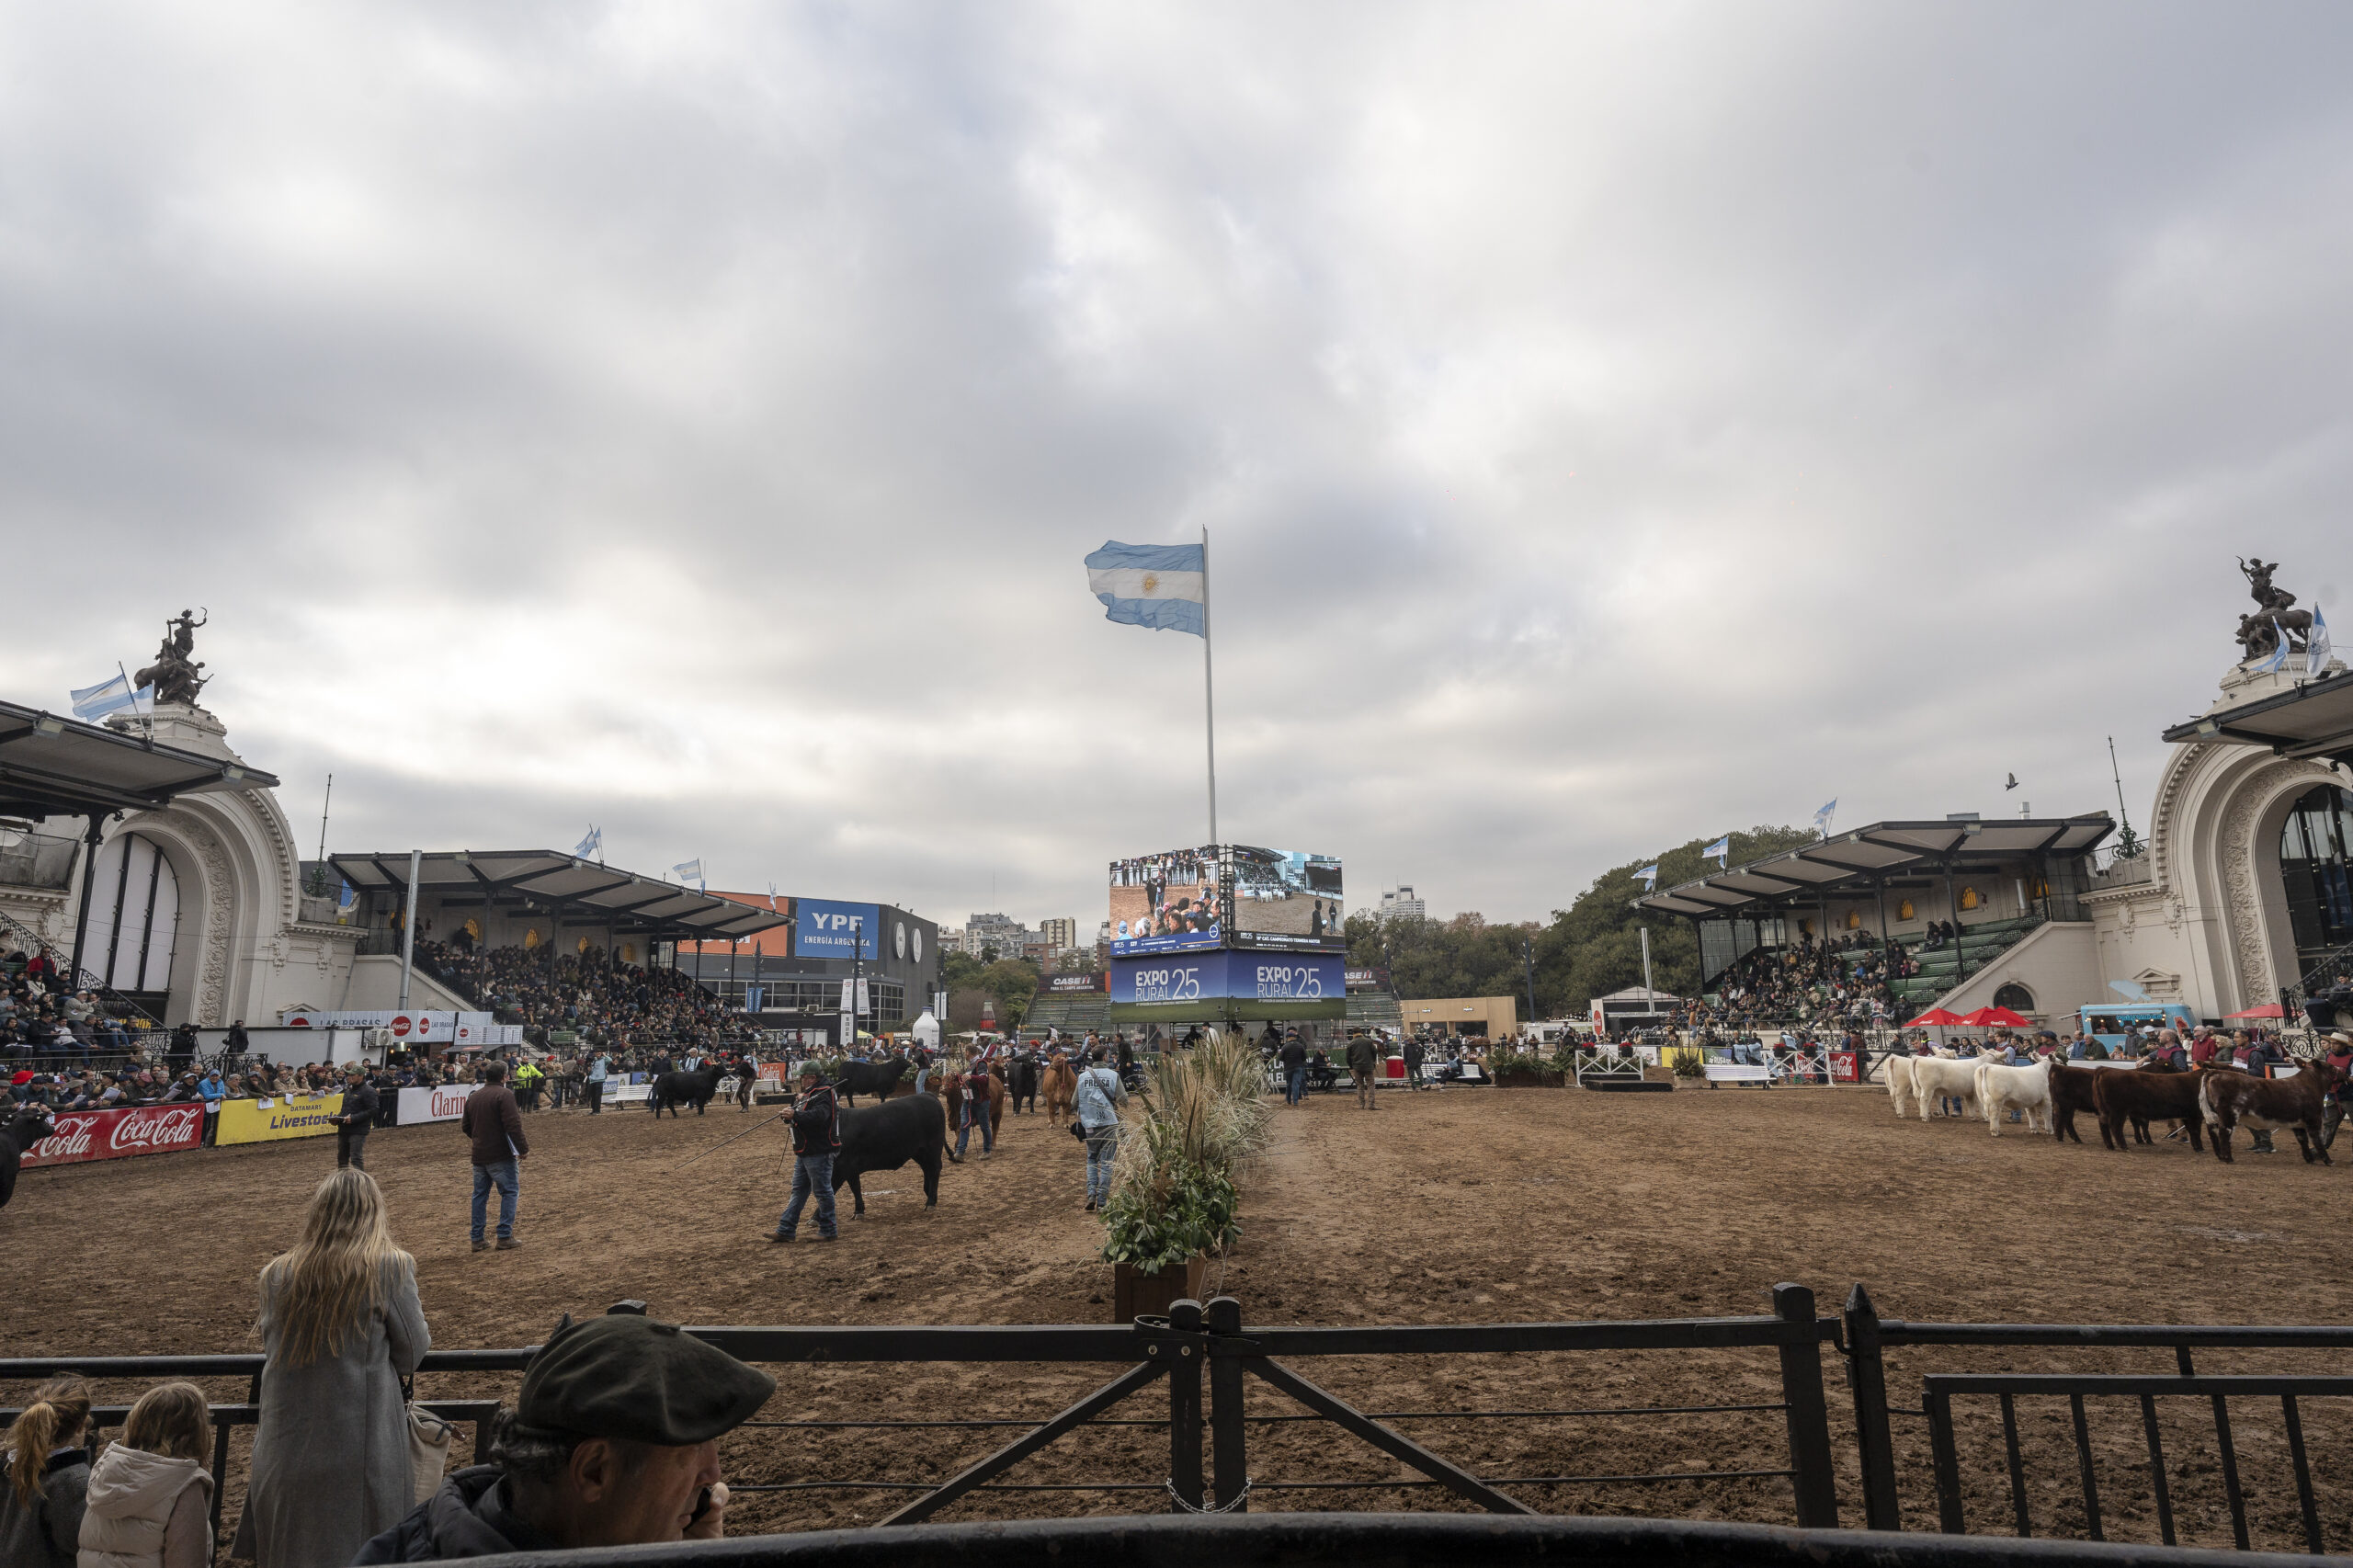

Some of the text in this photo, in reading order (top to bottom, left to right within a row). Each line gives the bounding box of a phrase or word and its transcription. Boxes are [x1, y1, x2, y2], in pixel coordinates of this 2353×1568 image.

[812, 913, 863, 931] YPF
[804, 935, 870, 947] ENERGÍA ARGENINA
[1053, 977, 1082, 985] CASE
[1135, 968, 1199, 1000] EXPO 25
[1256, 966, 1322, 998] EXPO 25
[1135, 986, 1171, 1002] RURAL
[1257, 983, 1294, 998] RURAL
[763, 1065, 779, 1079] Galicia
[1085, 1079, 1110, 1088] PRESA
[290, 1104, 322, 1112] DATAMARS
[431, 1091, 467, 1118] Clarín
[110, 1108, 200, 1150] Coca-Cola
